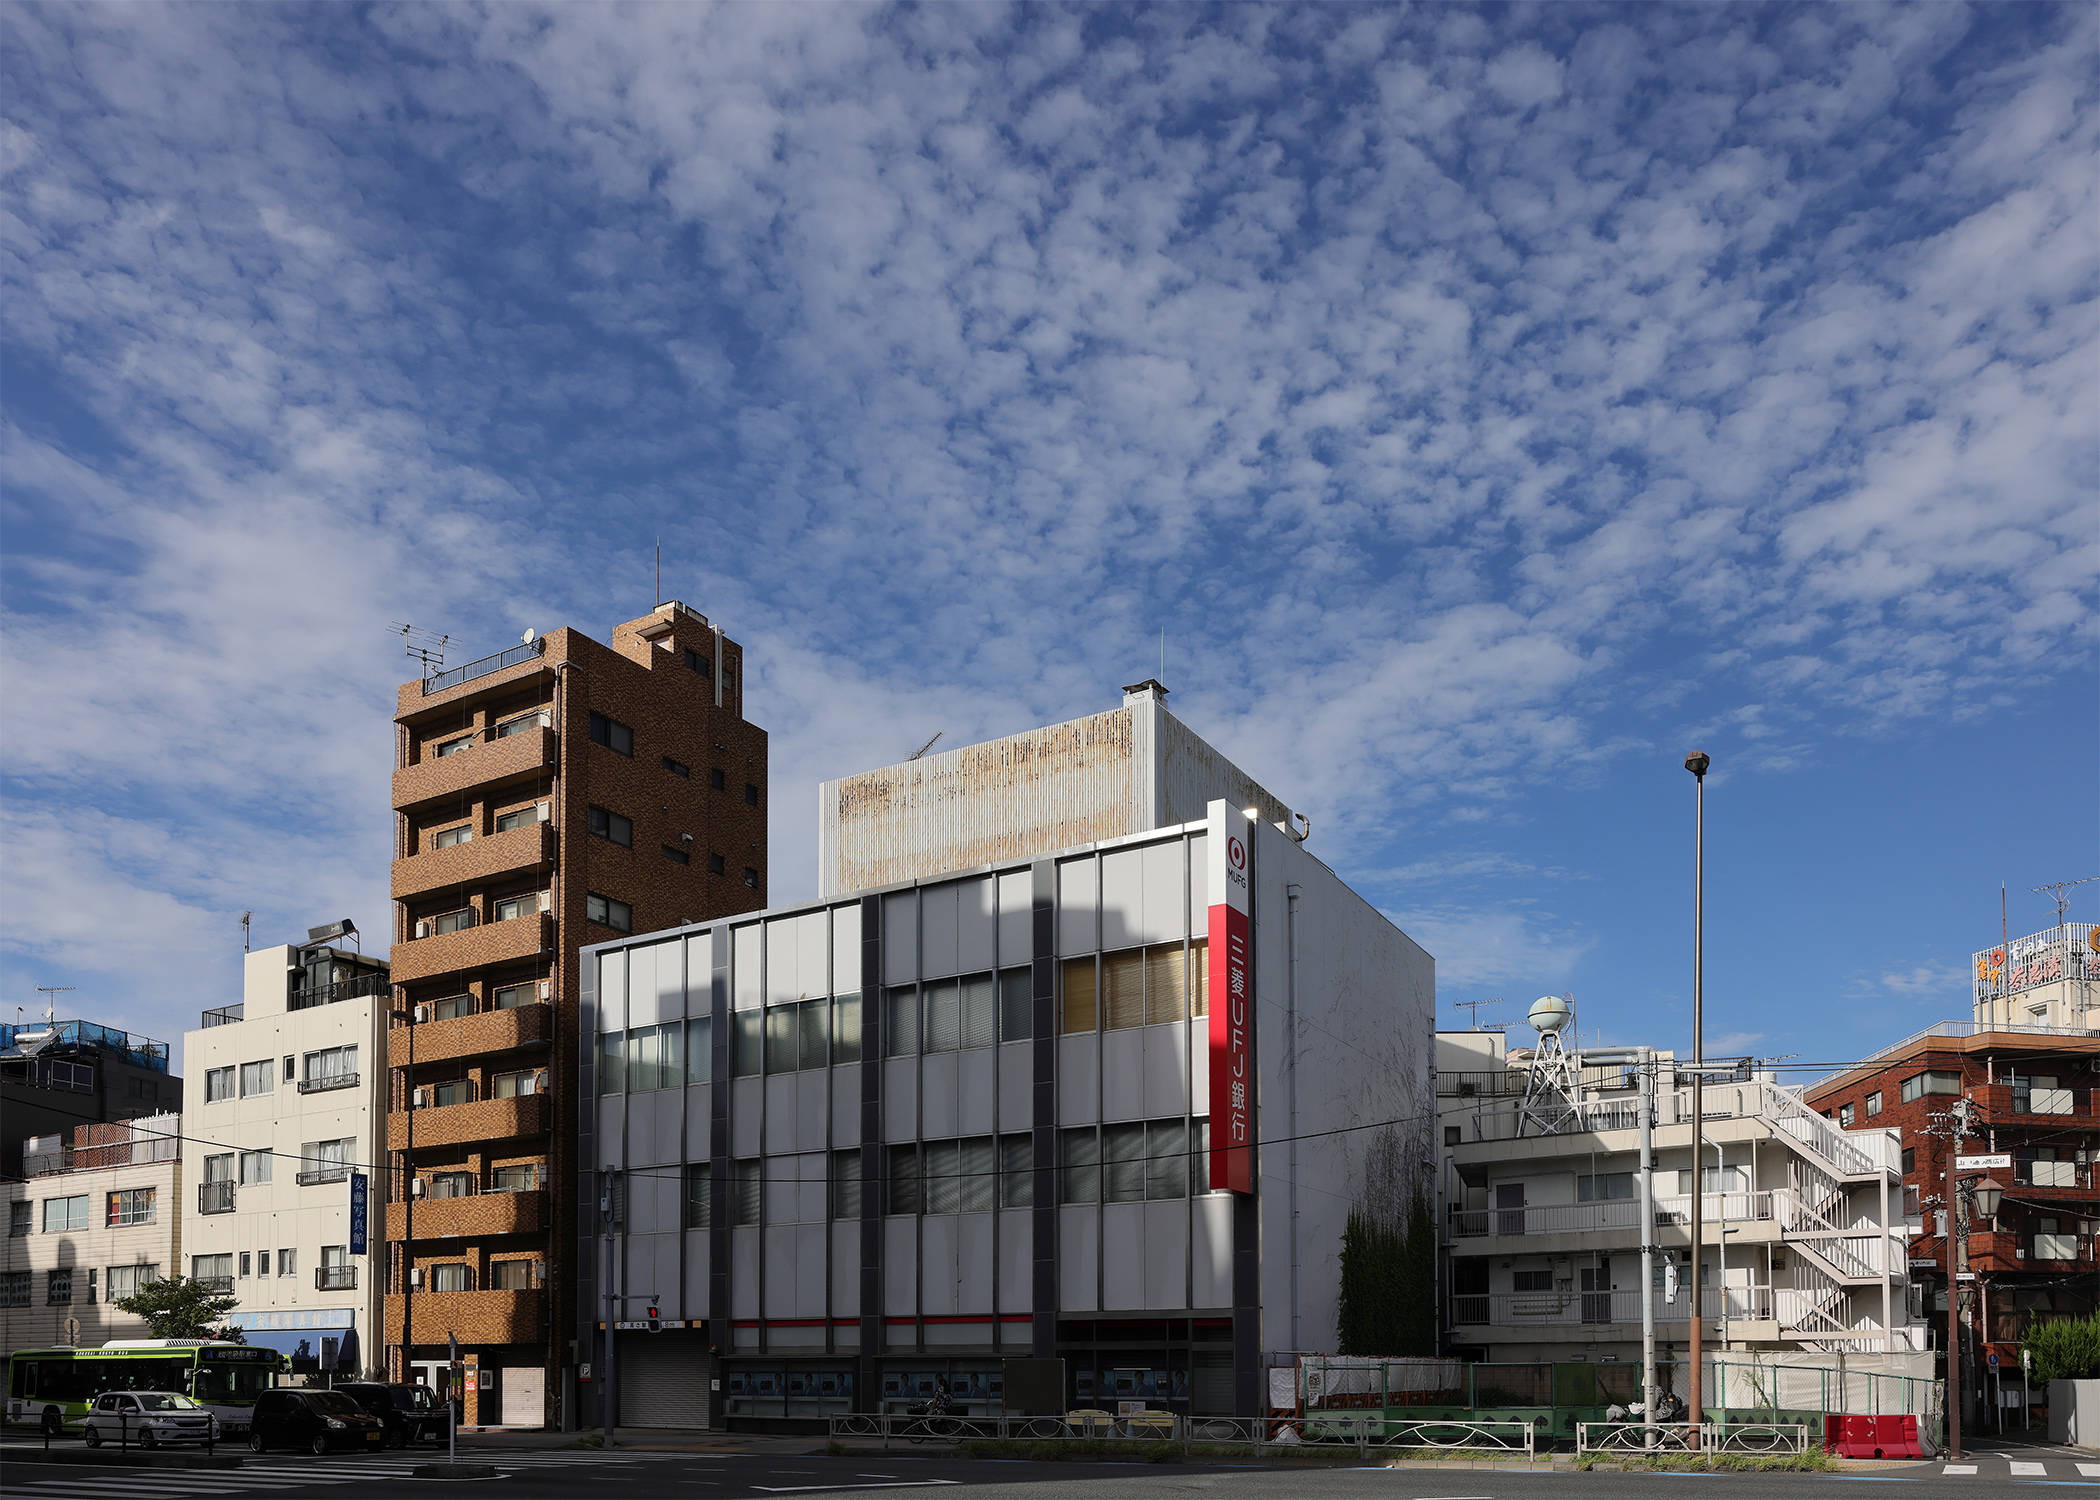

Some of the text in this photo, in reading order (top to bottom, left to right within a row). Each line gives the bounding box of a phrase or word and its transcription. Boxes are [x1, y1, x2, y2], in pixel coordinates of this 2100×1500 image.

[1228, 868, 1246, 889] MUFG
[1231, 933, 1245, 1142] 三菱UFJ銀行
[353, 1177, 365, 1245] 安藤写真館
